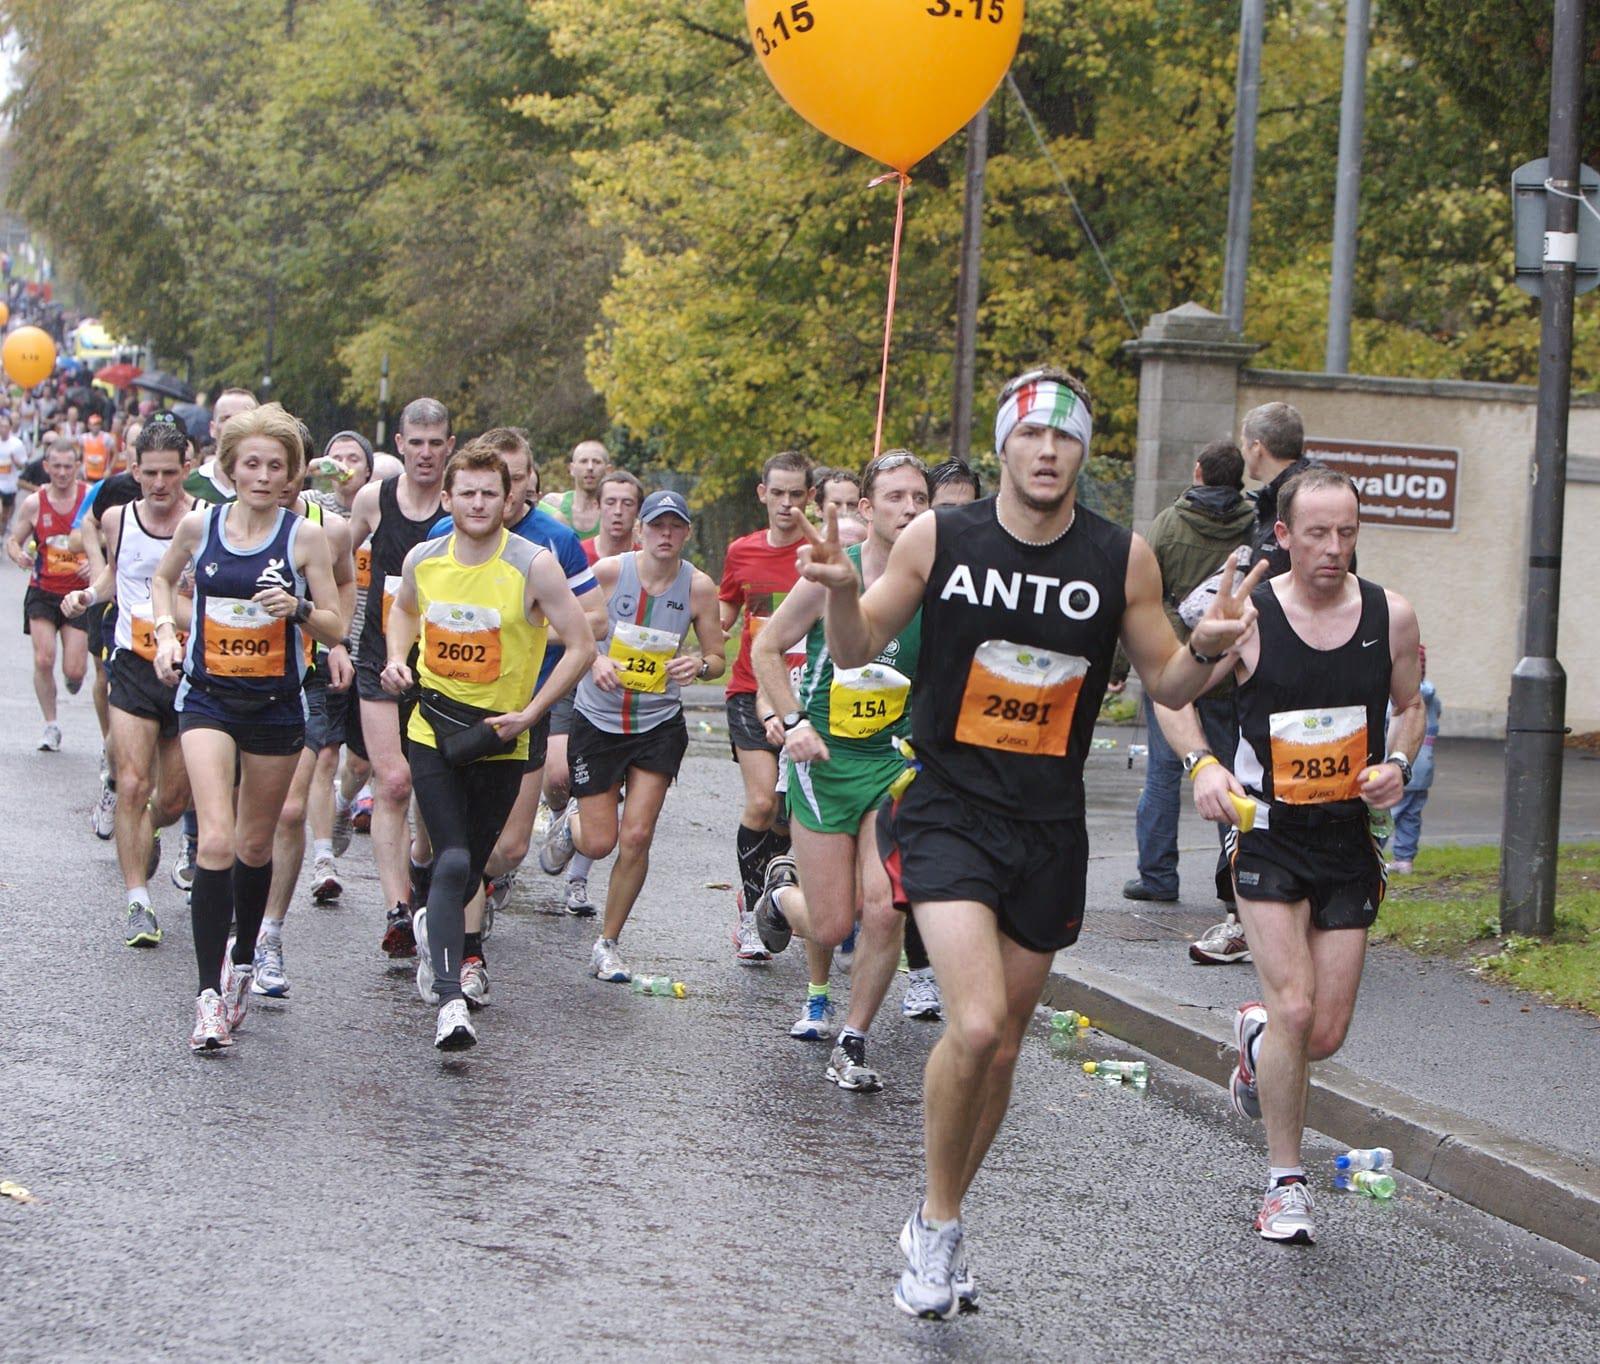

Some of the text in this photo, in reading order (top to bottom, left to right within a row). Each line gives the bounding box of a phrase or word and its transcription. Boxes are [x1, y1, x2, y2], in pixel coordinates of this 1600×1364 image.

[755, 0, 816, 56] 3.15
[1351, 473, 1447, 500] vaUCD
[939, 564, 1100, 621] ANTO
[666, 600, 684, 611] FILA
[218, 638, 270, 657] 1690
[437, 641, 486, 663] 2602
[626, 657, 657, 676] 134
[852, 699, 887, 719] 154
[983, 694, 1053, 726] 2891
[1291, 755, 1351, 780] 2834
